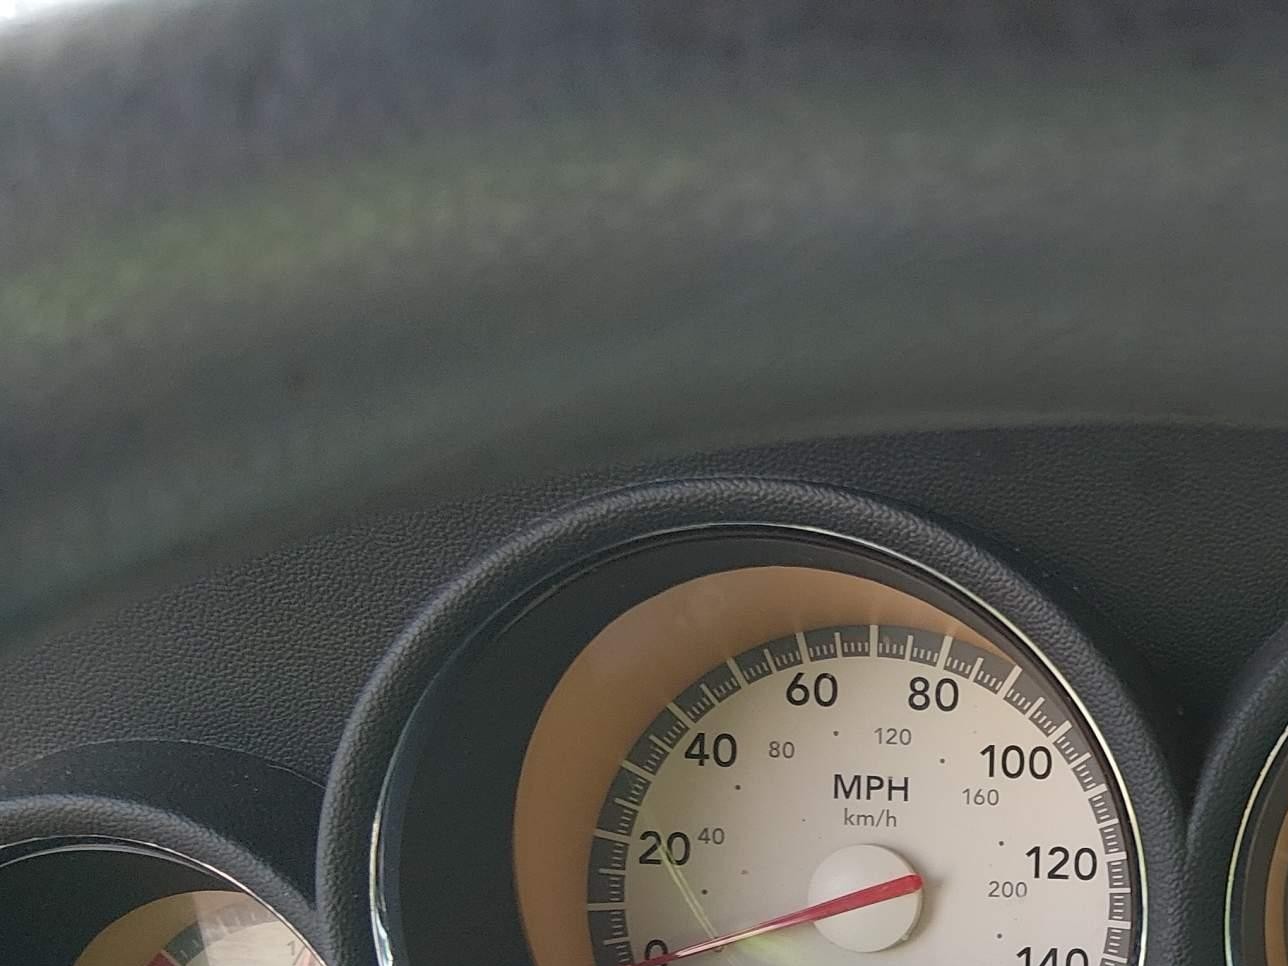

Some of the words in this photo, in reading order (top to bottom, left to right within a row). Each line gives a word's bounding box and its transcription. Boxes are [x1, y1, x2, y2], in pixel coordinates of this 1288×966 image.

[785, 672, 839, 708] 60
[907, 677, 960, 711] 80
[684, 732, 738, 767] 40
[768, 741, 795, 759] 80
[873, 727, 912, 746] 120
[979, 744, 1053, 780] 100
[832, 774, 910, 802] MPH
[962, 787, 999, 806] 160
[842, 808, 898, 828] km/h
[638, 830, 690, 866] 20
[698, 827, 725, 846] 40
[1025, 846, 1097, 880] 120
[988, 881, 1028, 899] 200
